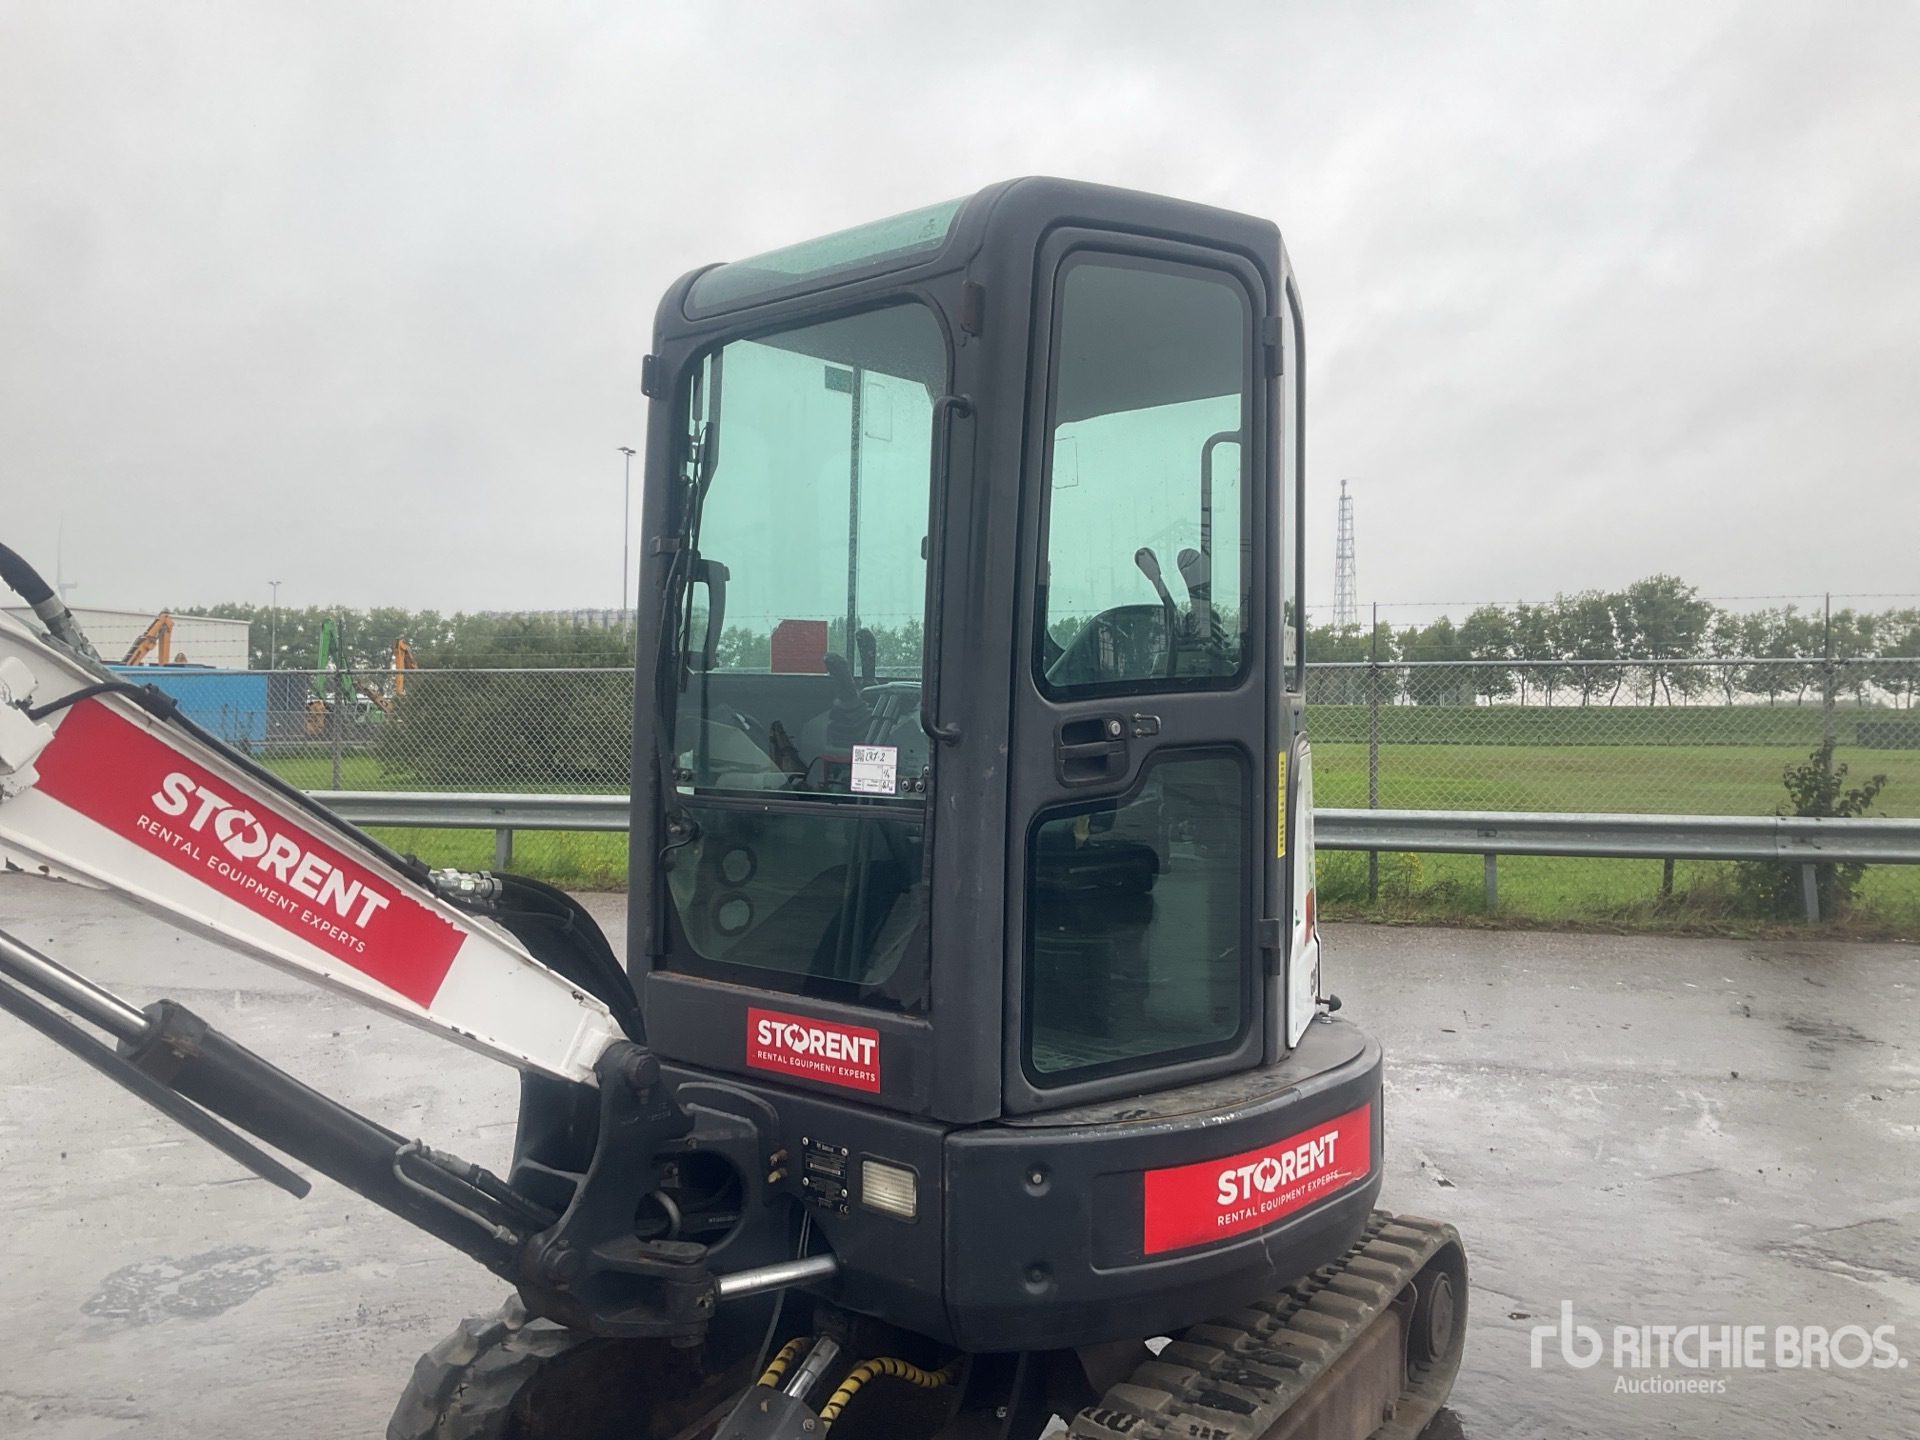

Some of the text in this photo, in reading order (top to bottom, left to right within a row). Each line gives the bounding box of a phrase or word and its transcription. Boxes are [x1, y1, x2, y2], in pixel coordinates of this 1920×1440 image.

[136, 814, 366, 953] RENTAL EQUIPMENT EXPERTS
[151, 772, 389, 929] STORENT
[757, 1019, 876, 1065] STORENT
[757, 1050, 876, 1082] RENTAL EQUIPMENT EXPERTS
[1217, 1130, 1339, 1206] STORENT
[1217, 1170, 1339, 1226] RENTAL EQUIPMENT EXPERTS
